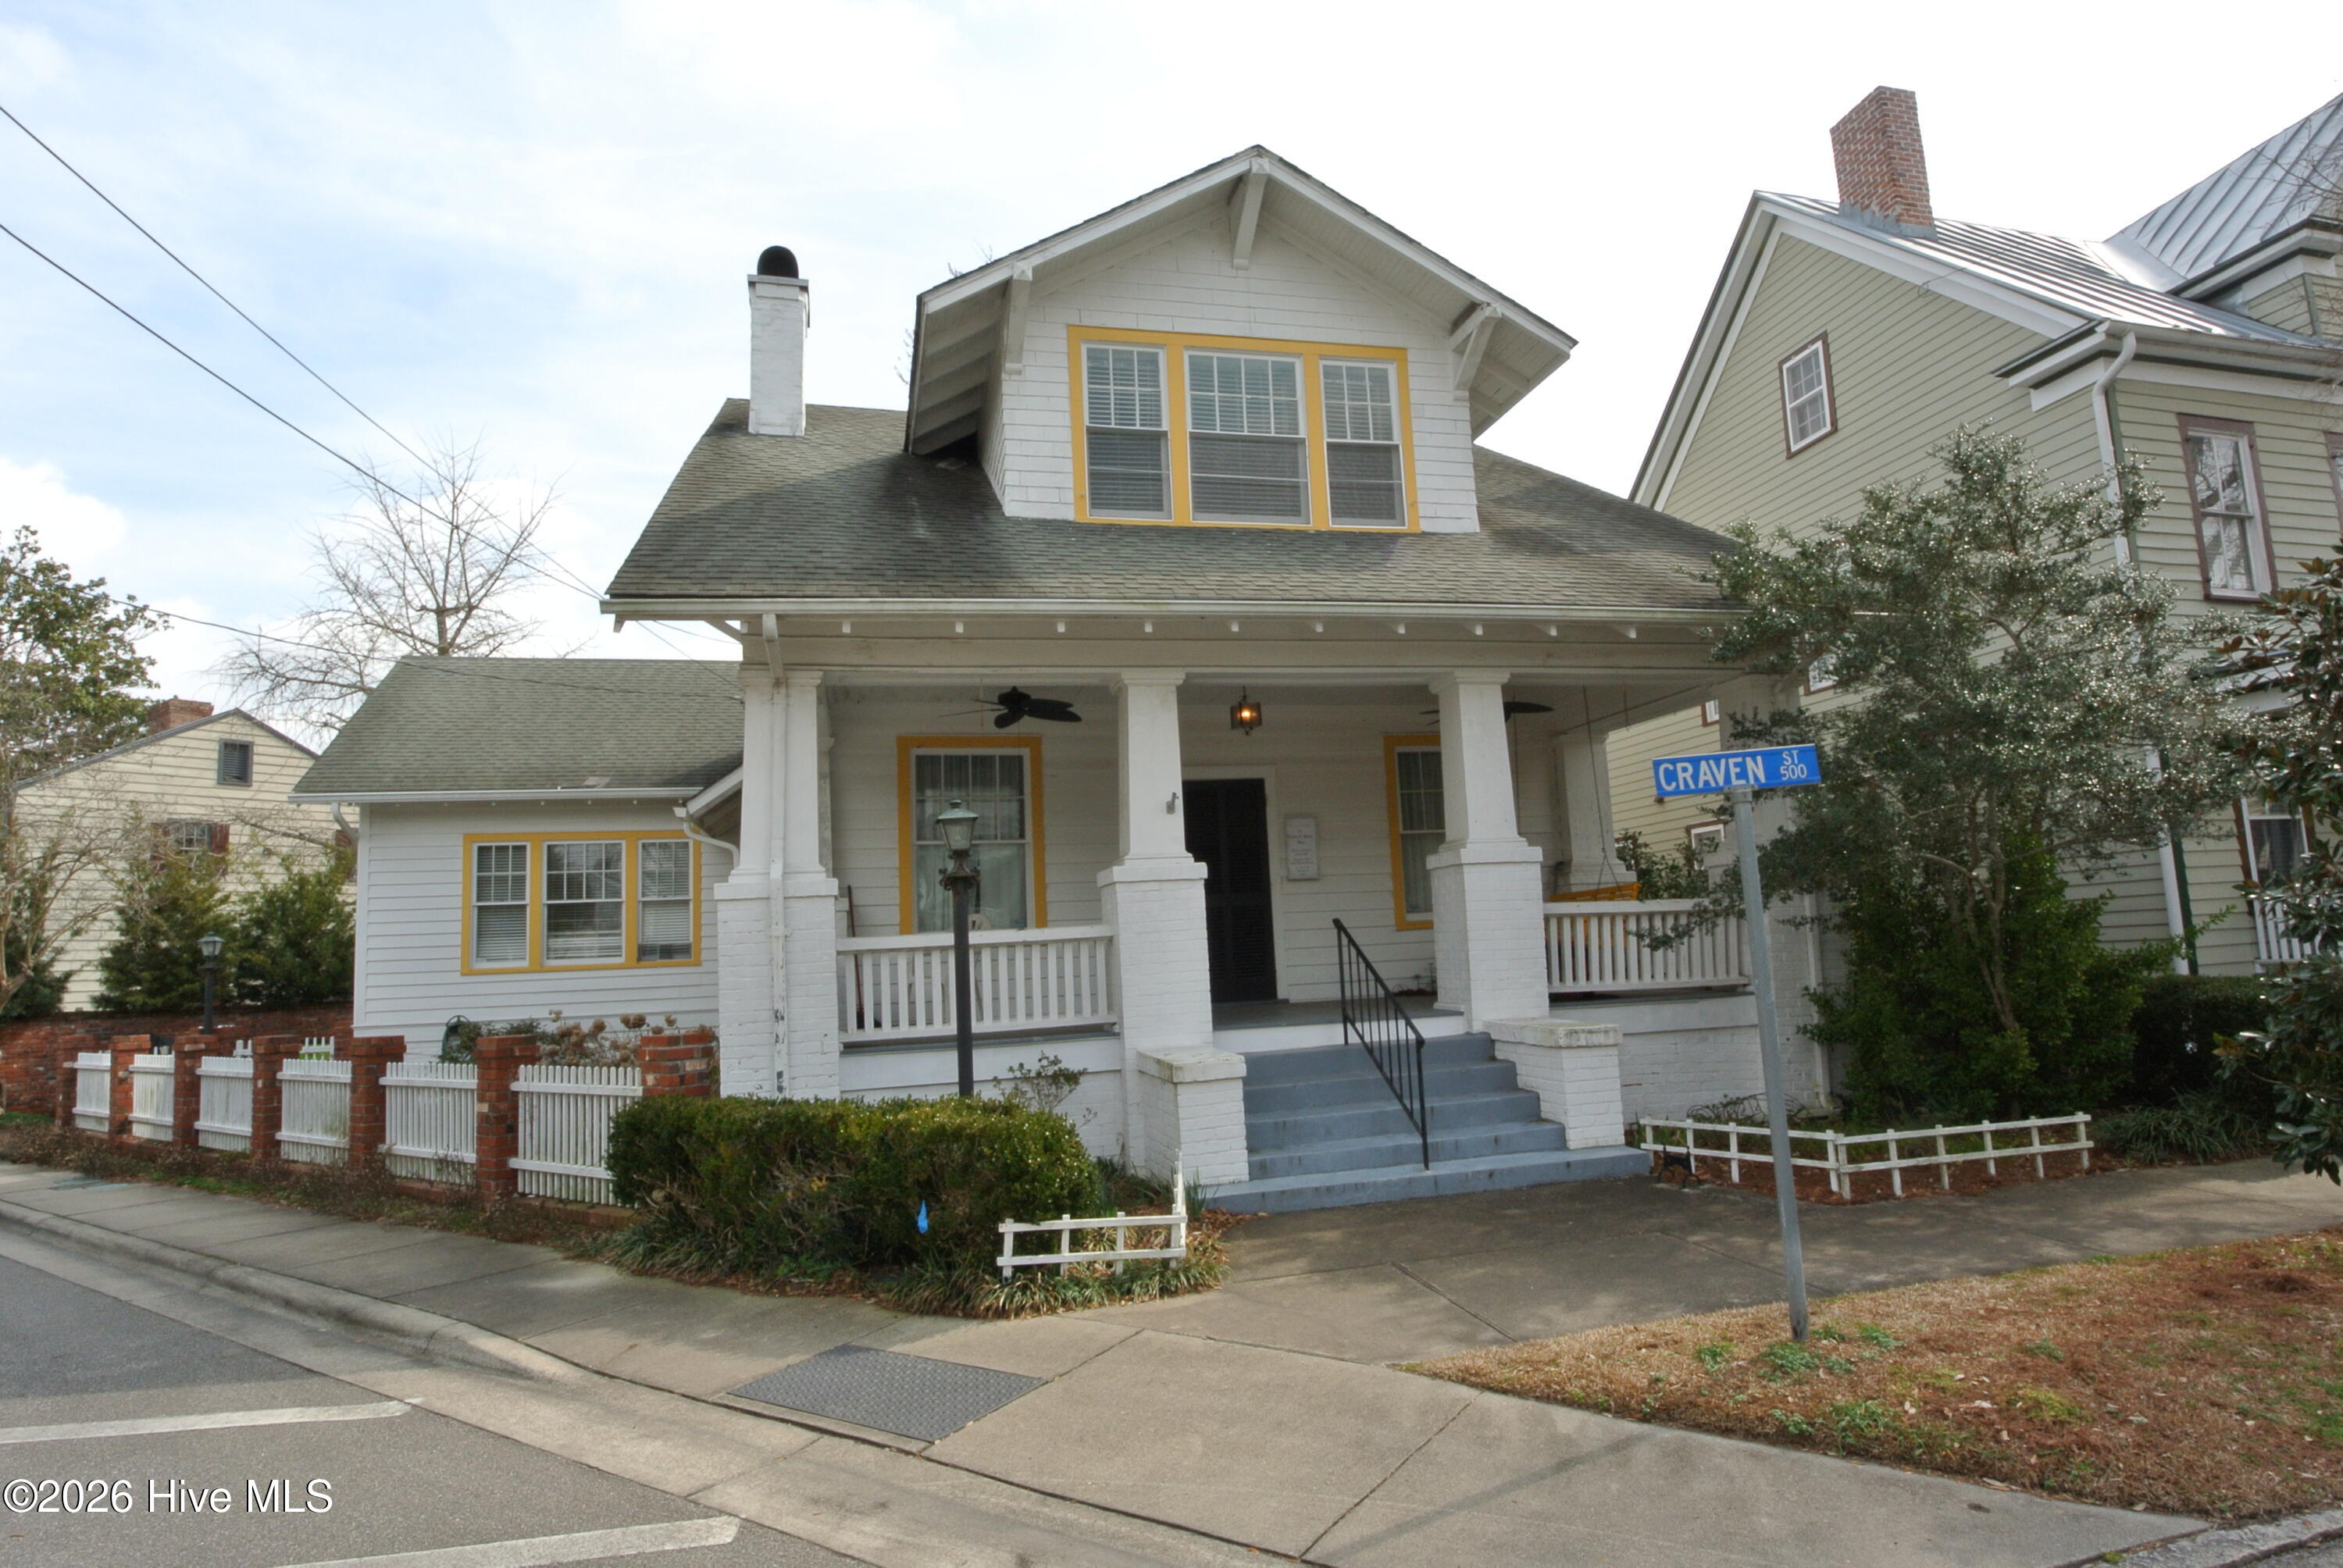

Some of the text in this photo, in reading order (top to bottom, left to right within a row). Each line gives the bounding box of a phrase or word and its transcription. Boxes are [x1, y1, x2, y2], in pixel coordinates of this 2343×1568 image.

[1782, 750, 1799, 765] ST
[1658, 755, 1766, 792] CRAVEN
[1780, 764, 1807, 781] 500
